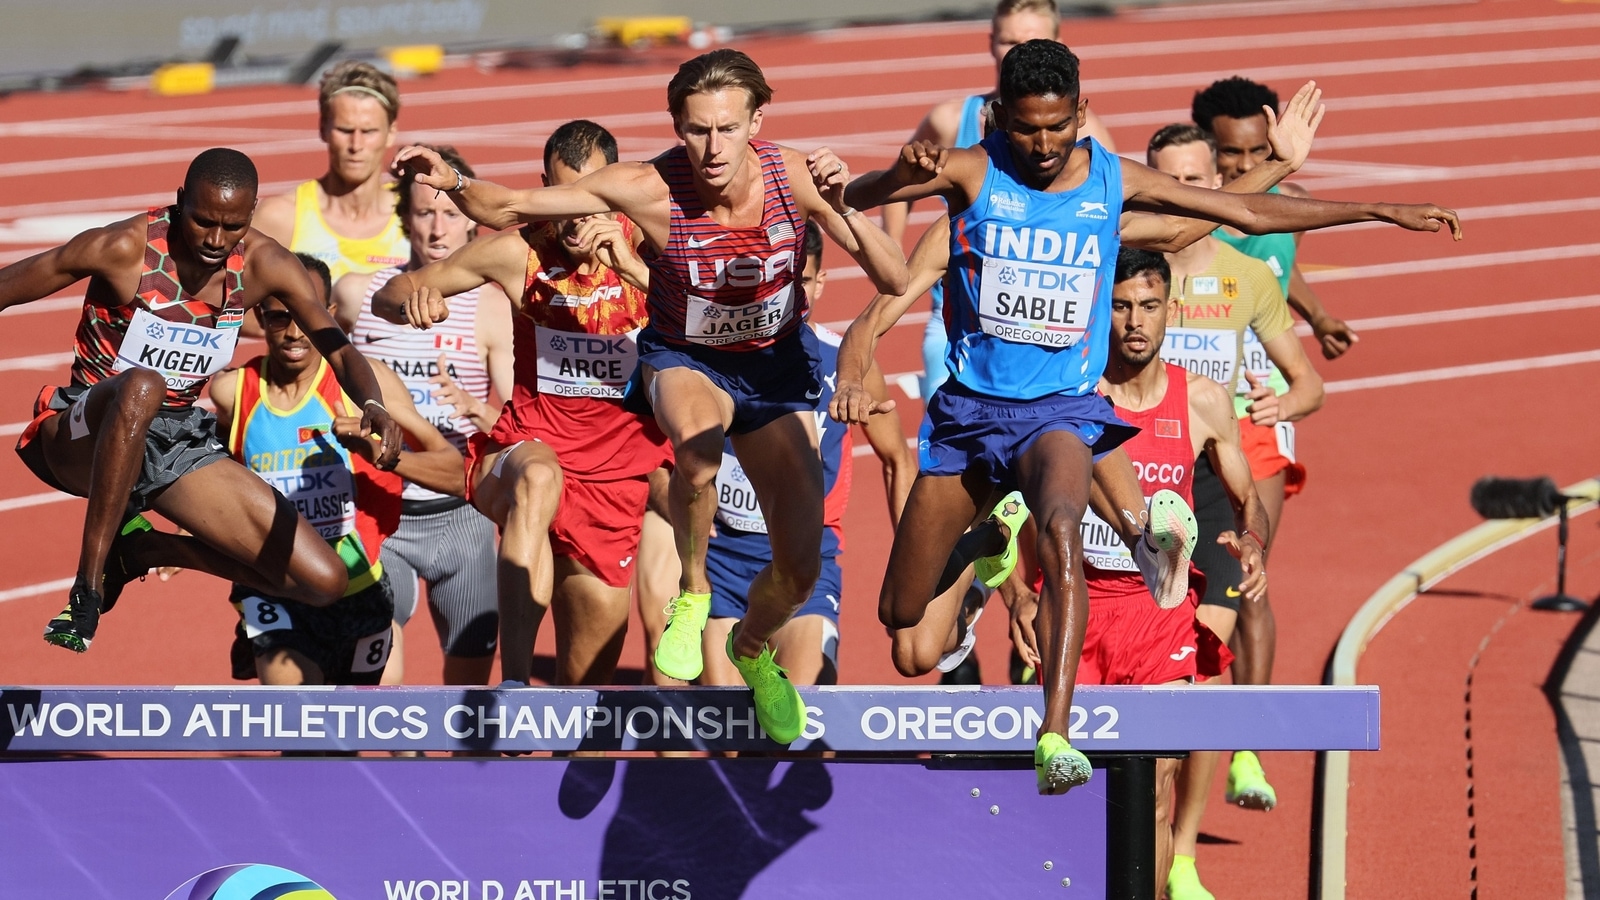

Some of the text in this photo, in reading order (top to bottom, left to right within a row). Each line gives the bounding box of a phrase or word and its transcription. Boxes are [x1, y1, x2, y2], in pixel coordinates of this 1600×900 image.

[985, 223, 1101, 268] INDIA
[688, 250, 795, 289] USA
[1018, 268, 1082, 293] TDK
[721, 294, 782, 318] TDK
[995, 291, 1078, 324] SABLE
[702, 308, 782, 335] JAGER
[166, 326, 224, 350] TDK
[566, 336, 628, 355] TDK
[994, 324, 1072, 346] OREGON22
[1166, 333, 1220, 352] TDK
[138, 343, 213, 374] KIGEN
[558, 357, 623, 379] ARCE
[277, 470, 337, 494] TDK
[1131, 460, 1184, 485] OCCO
[720, 483, 758, 512] BOU
[257, 602, 279, 625] 8
[366, 638, 385, 665] 8
[7, 702, 1119, 741] WORLD ATHLETICS CHAMPIONSHS OREGON22
[383, 879, 692, 900] WORLD ATHLETICS
